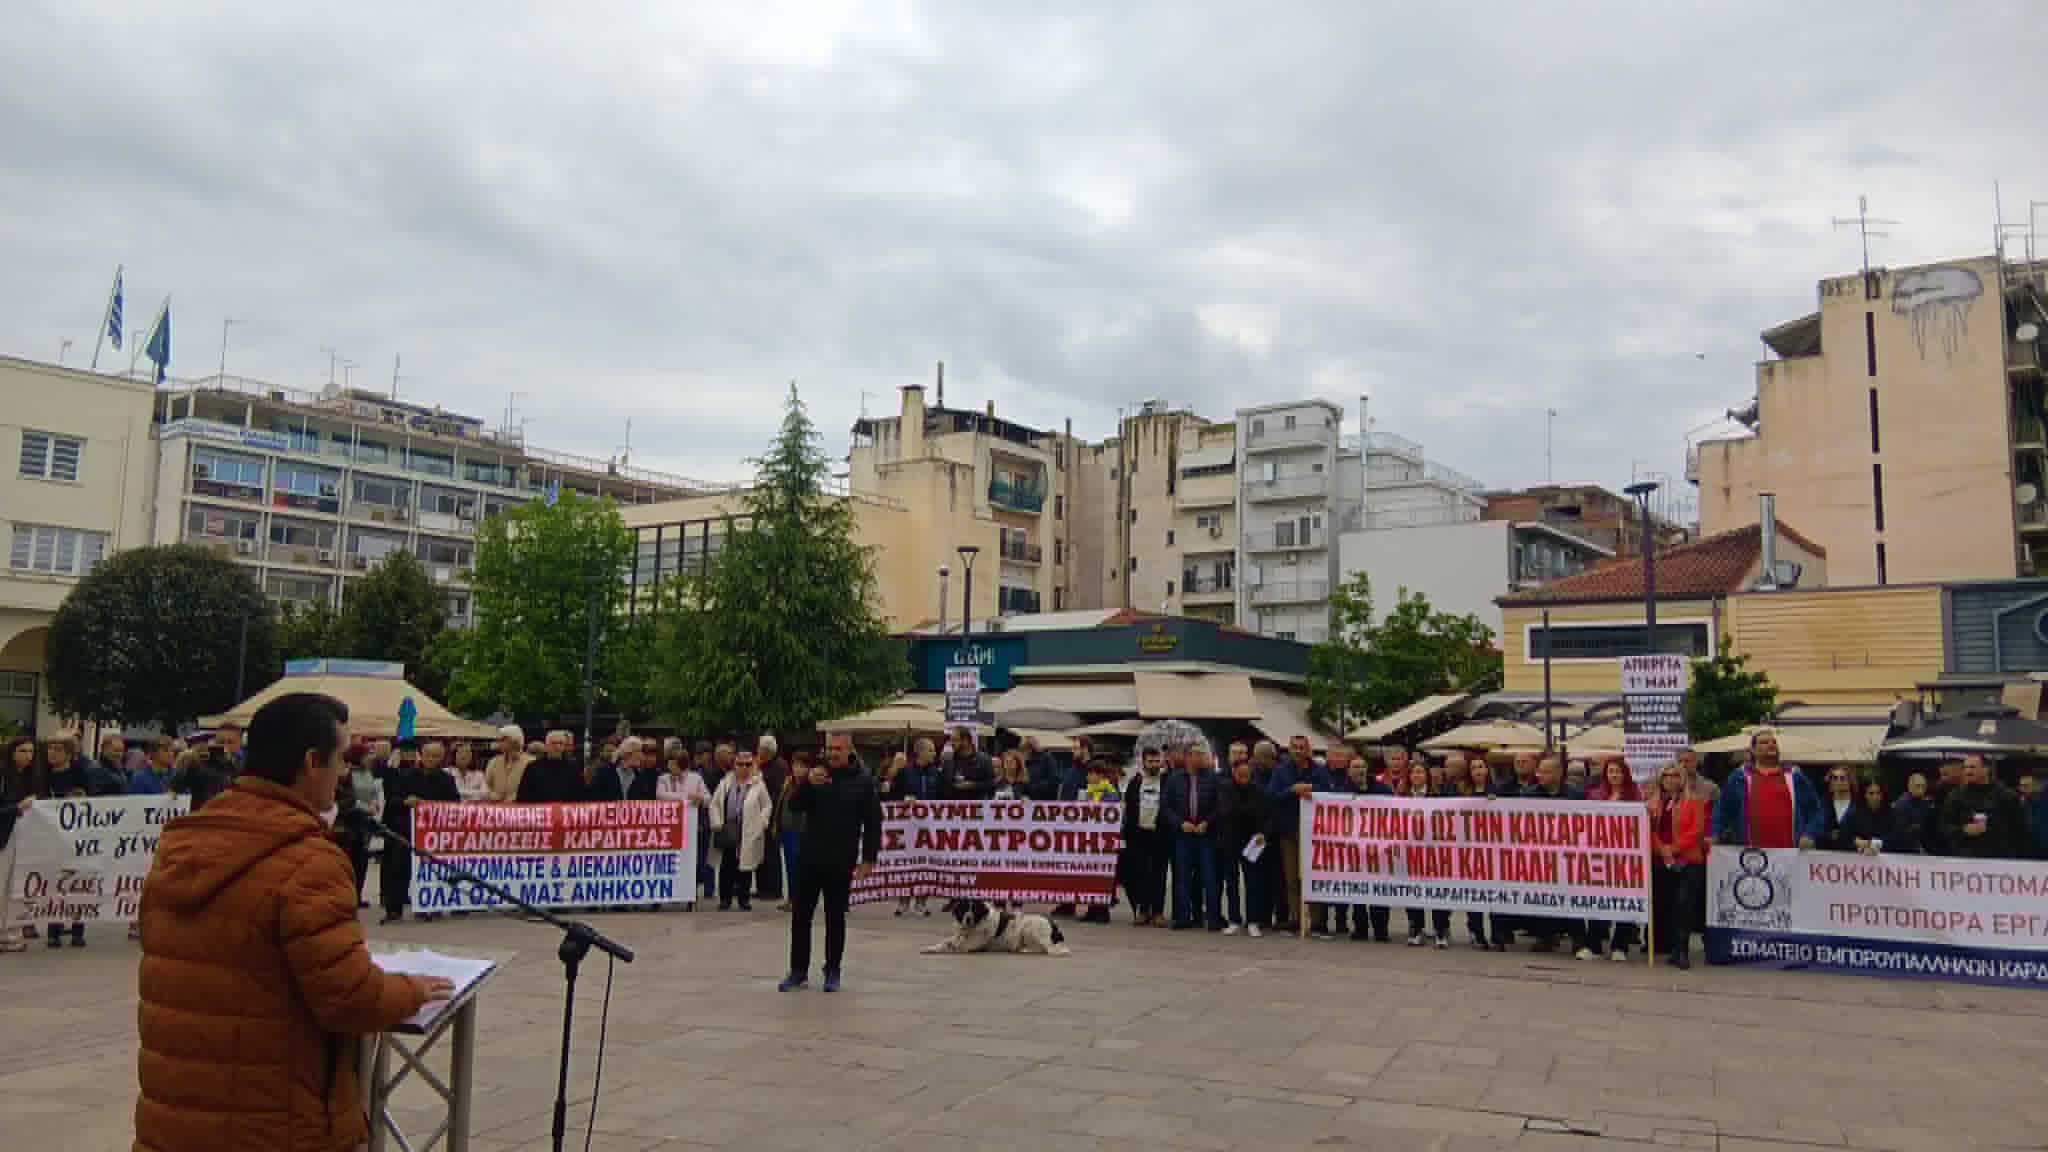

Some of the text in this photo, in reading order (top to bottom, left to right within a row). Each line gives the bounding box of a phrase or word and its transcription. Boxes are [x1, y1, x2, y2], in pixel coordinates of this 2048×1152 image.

[881, 802, 1120, 823] ΙΖΟΥΜΕ ΤΟ ΔΡΟΜΟ
[1312, 803, 1641, 849] ΑΠΟ ΣΙΚΑΓΟ ΩΣ ΤΗΝ ΚΑΙΣΑΡΙΑΝΗ
[423, 828, 672, 852] ΟΡΓΑΝΩΣΕΙΣ ΚΑΡΔΙΤΣΑΣ
[914, 827, 1120, 853] ΑΝΑΤΡΟΠΗΣ
[567, 852, 680, 879] ΔΙΕΚΔΙΚΟΥΜΕ
[1312, 840, 1361, 873] ΖΗΤΩ
[1366, 843, 1380, 875] Η
[1407, 846, 1453, 880] ΜΑΗ
[1458, 847, 1495, 882] ΚΑΙ
[1500, 847, 1559, 885] ΠΑΛΗ
[1563, 851, 1645, 889] ΤΑΞΙΚΗ
[1808, 863, 1921, 889] ΚΟΚΚΙΝΗ
[418, 884, 461, 907] ΟΛΑ
[520, 881, 566, 905] ΜΑΣ
[571, 877, 673, 902] ΑΝΗΚΟΥΝ
[1373, 882, 1423, 899] ΚΕΝΤΡΟ
[1828, 903, 1983, 934] ΠΡΩΤΟΠΟΡΑ
[1731, 937, 1813, 961] ΣΩΜΑΤΕΙΟ
[1816, 944, 1996, 978] ΕΜΠΟΡΟΥΠΑΛΛΗΛΩΝ
